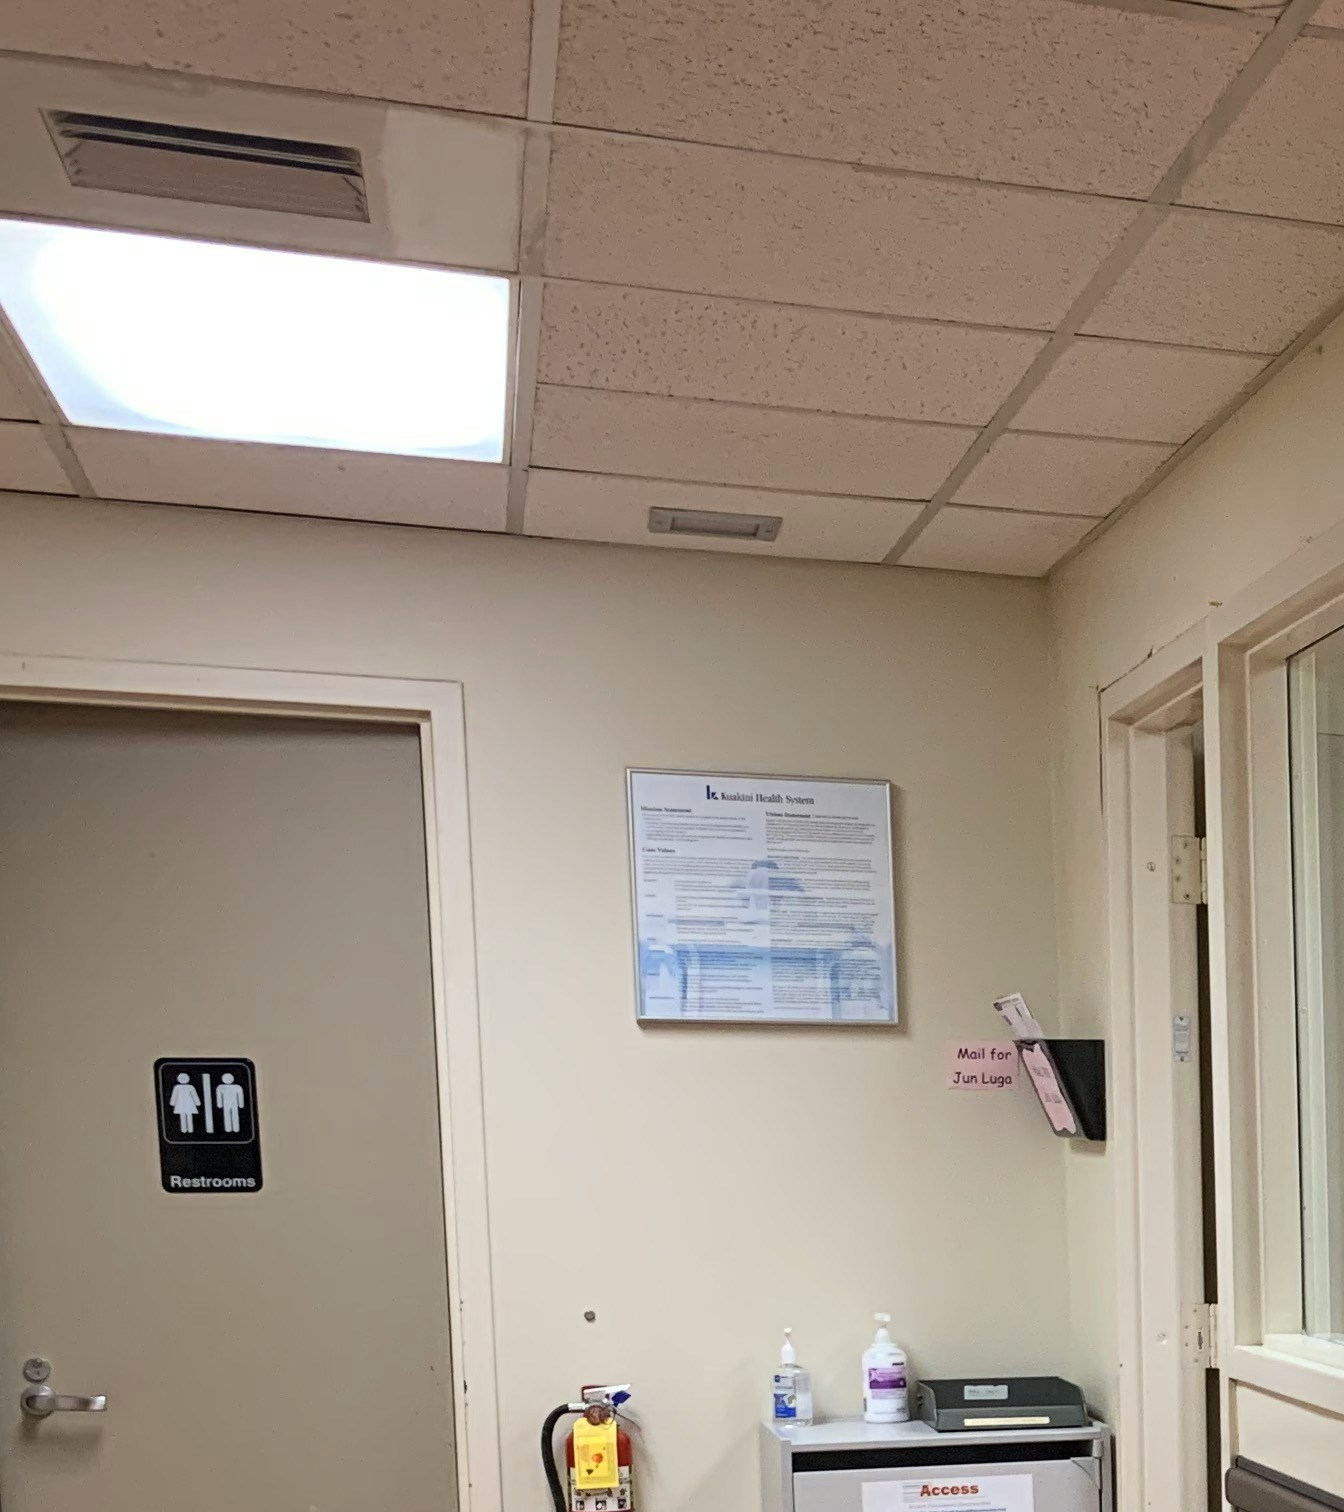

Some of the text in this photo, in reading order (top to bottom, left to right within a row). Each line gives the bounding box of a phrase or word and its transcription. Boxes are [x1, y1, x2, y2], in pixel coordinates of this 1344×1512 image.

[721, 792, 815, 806] Kuakini Health System
[957, 1048, 1012, 1060] Mail for
[953, 1072, 1012, 1088] Jun Luga
[170, 1176, 256, 1188] Restrooms
[920, 1484, 980, 1497] Access
